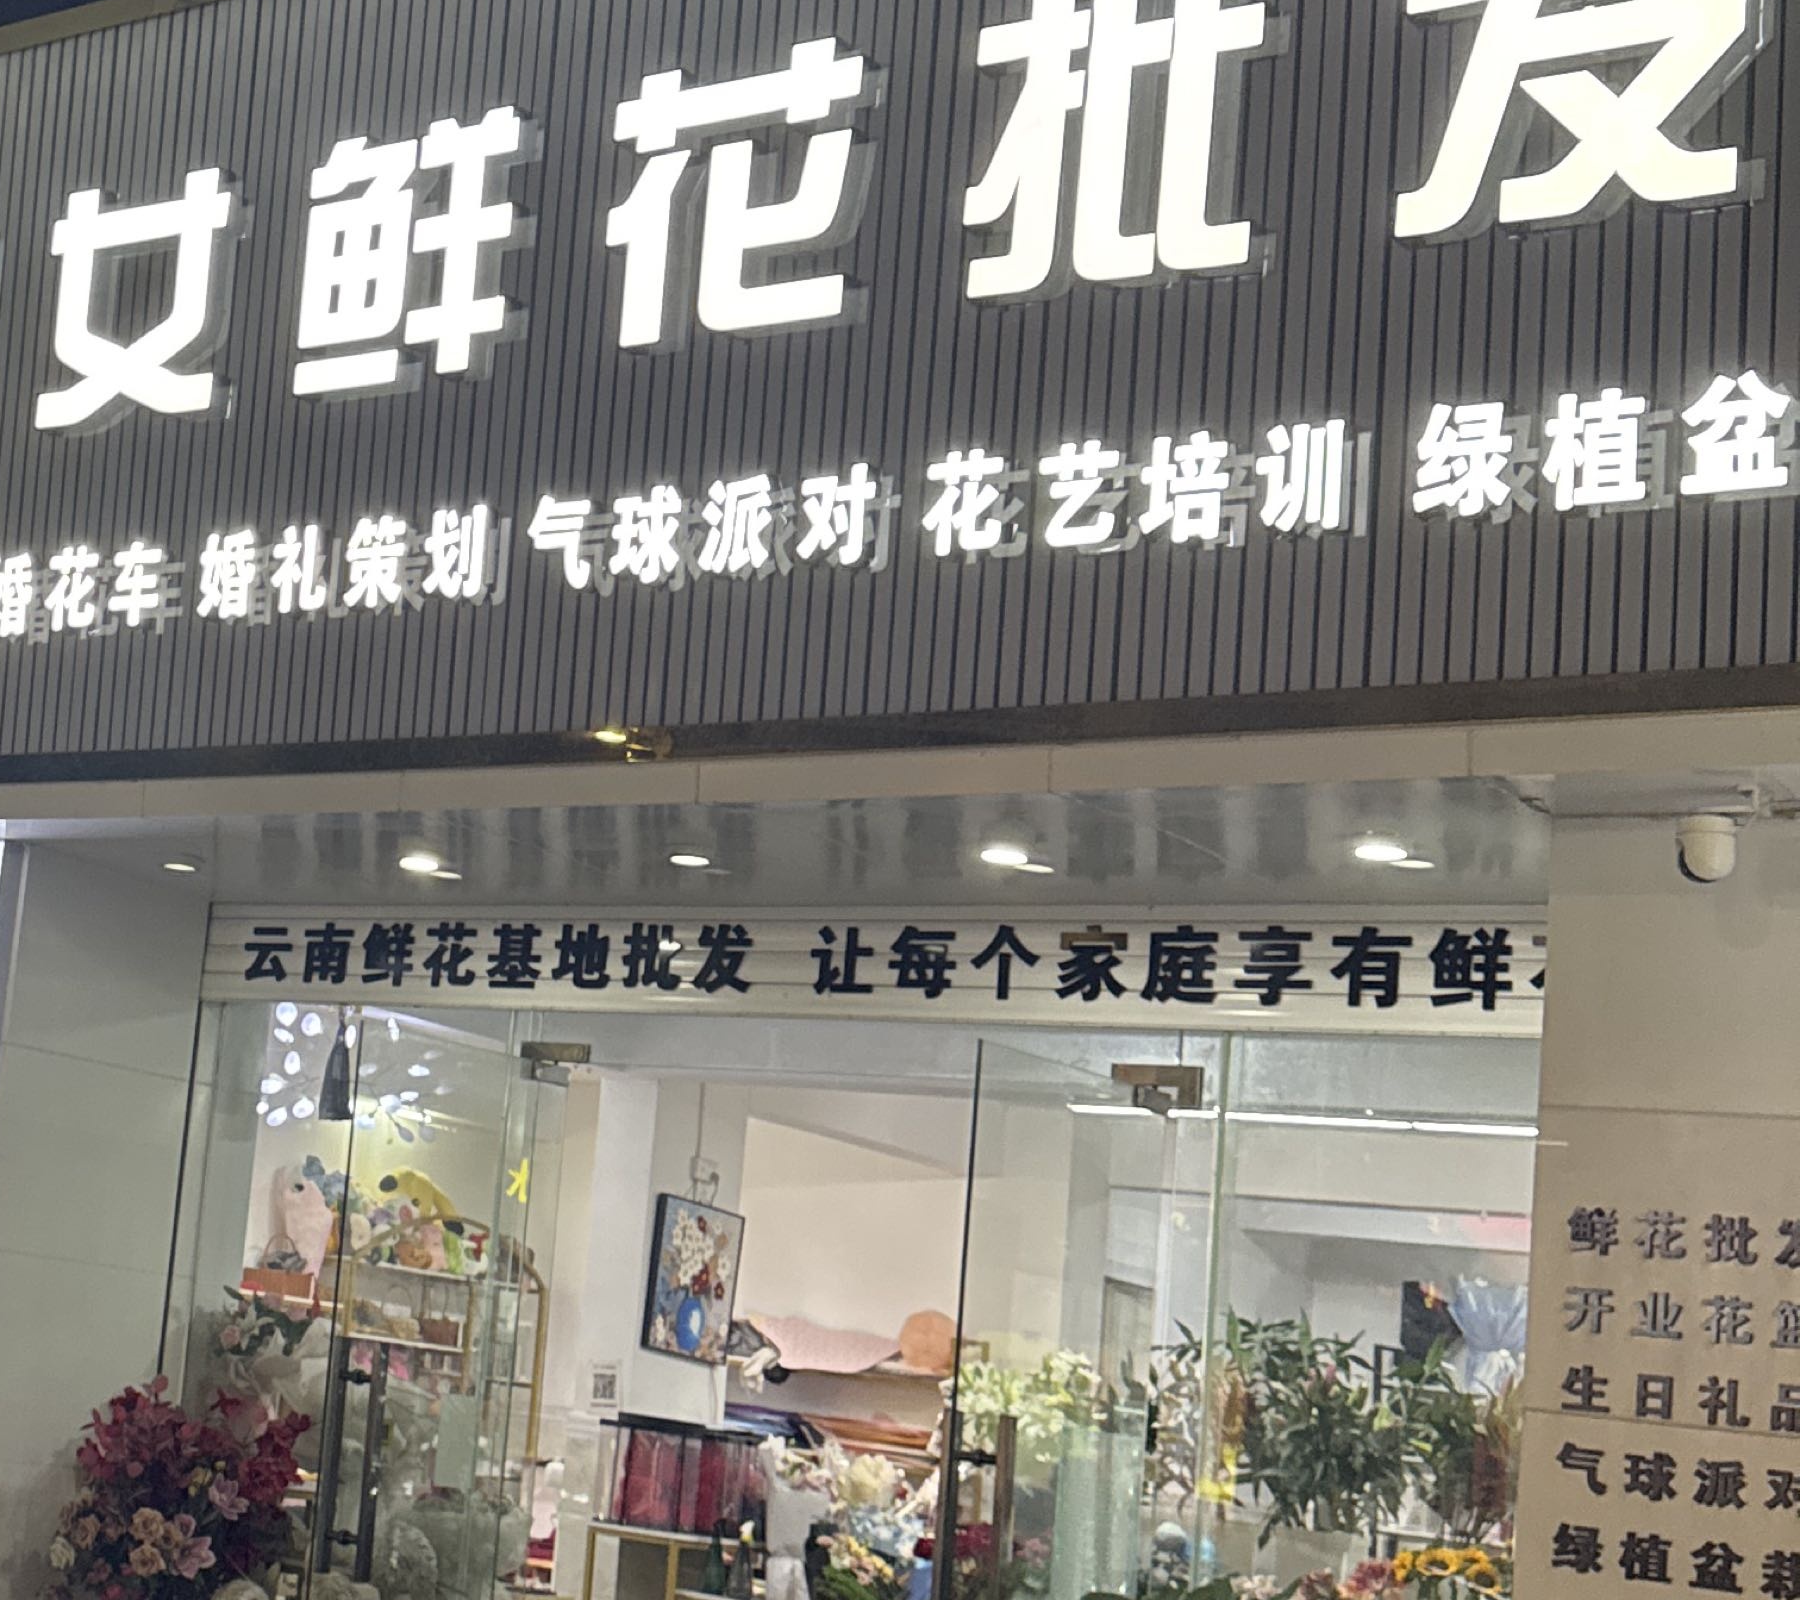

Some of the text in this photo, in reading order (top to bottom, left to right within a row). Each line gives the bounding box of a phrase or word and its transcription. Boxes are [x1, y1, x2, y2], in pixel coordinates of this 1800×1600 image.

[197, 504, 488, 618] 婚礼策划
[528, 463, 877, 588] 气球派对
[922, 419, 1345, 556] 花艺培训
[1413, 370, 1791, 516] 绿植盆
[243, 921, 1546, 1011] 云南鲜花基地批发 让每个家庭享有鲜
